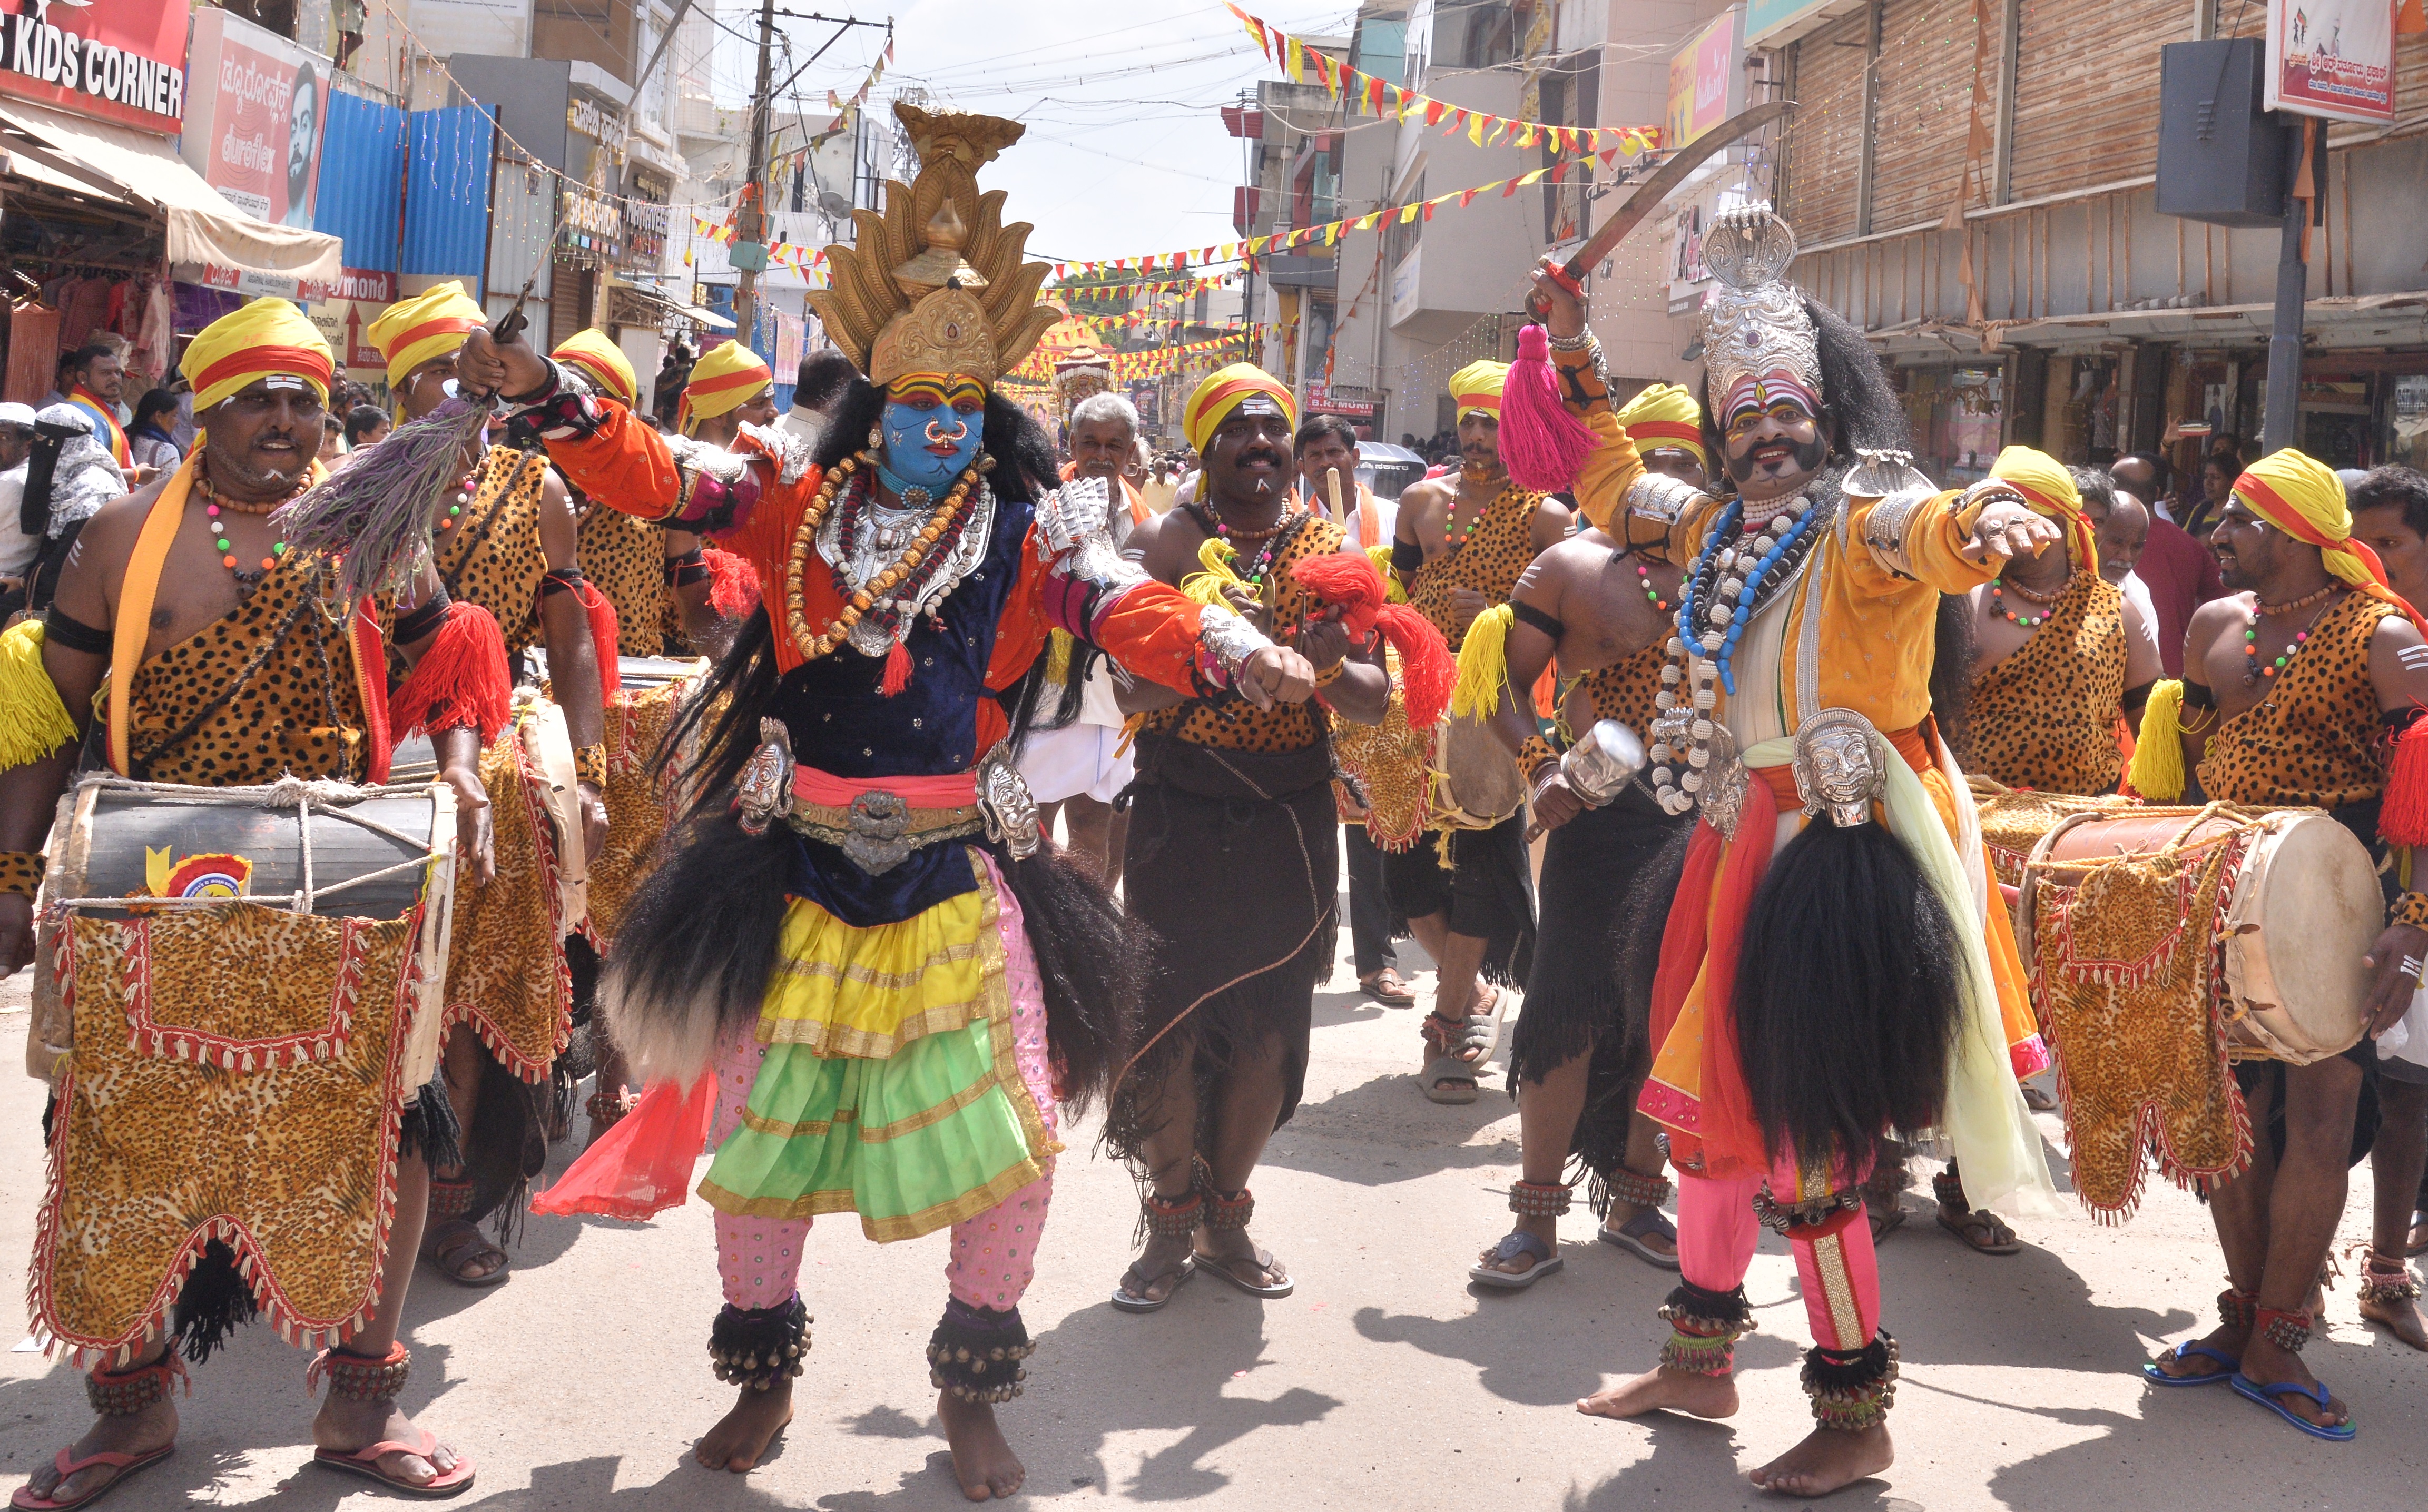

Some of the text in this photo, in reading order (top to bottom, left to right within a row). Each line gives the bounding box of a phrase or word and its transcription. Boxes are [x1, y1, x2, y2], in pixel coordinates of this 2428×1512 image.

[13, 14, 79, 88] KIDS
[86, 39, 183, 119] CORNER
[222, 123, 276, 174] duroflex
[582, 196, 621, 240] FASHIONS
